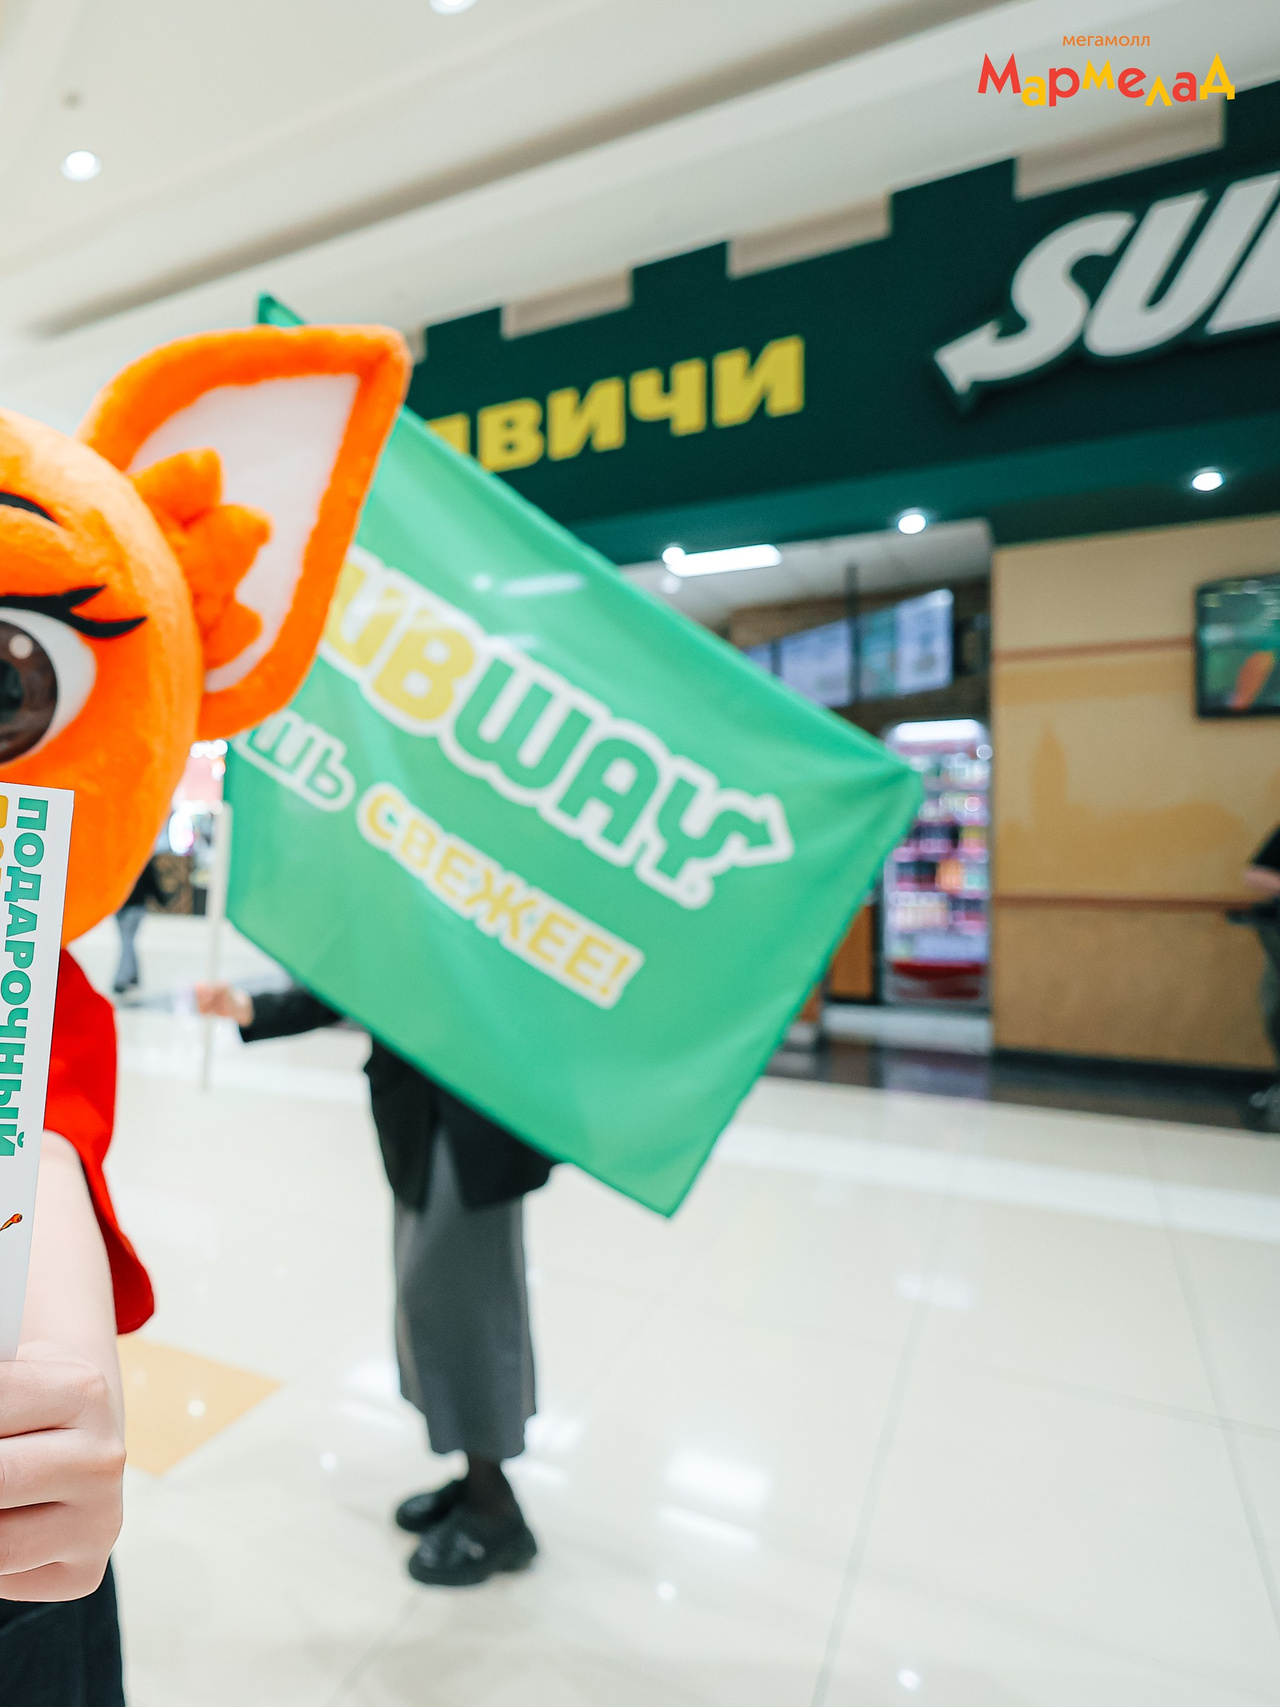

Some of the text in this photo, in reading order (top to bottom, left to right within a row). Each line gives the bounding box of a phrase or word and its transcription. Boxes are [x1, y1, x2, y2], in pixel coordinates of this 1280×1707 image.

[243, 710, 633, 998] ШЬ СВЕЖЕЕ!
[320, 555, 780, 882] UBWAY
